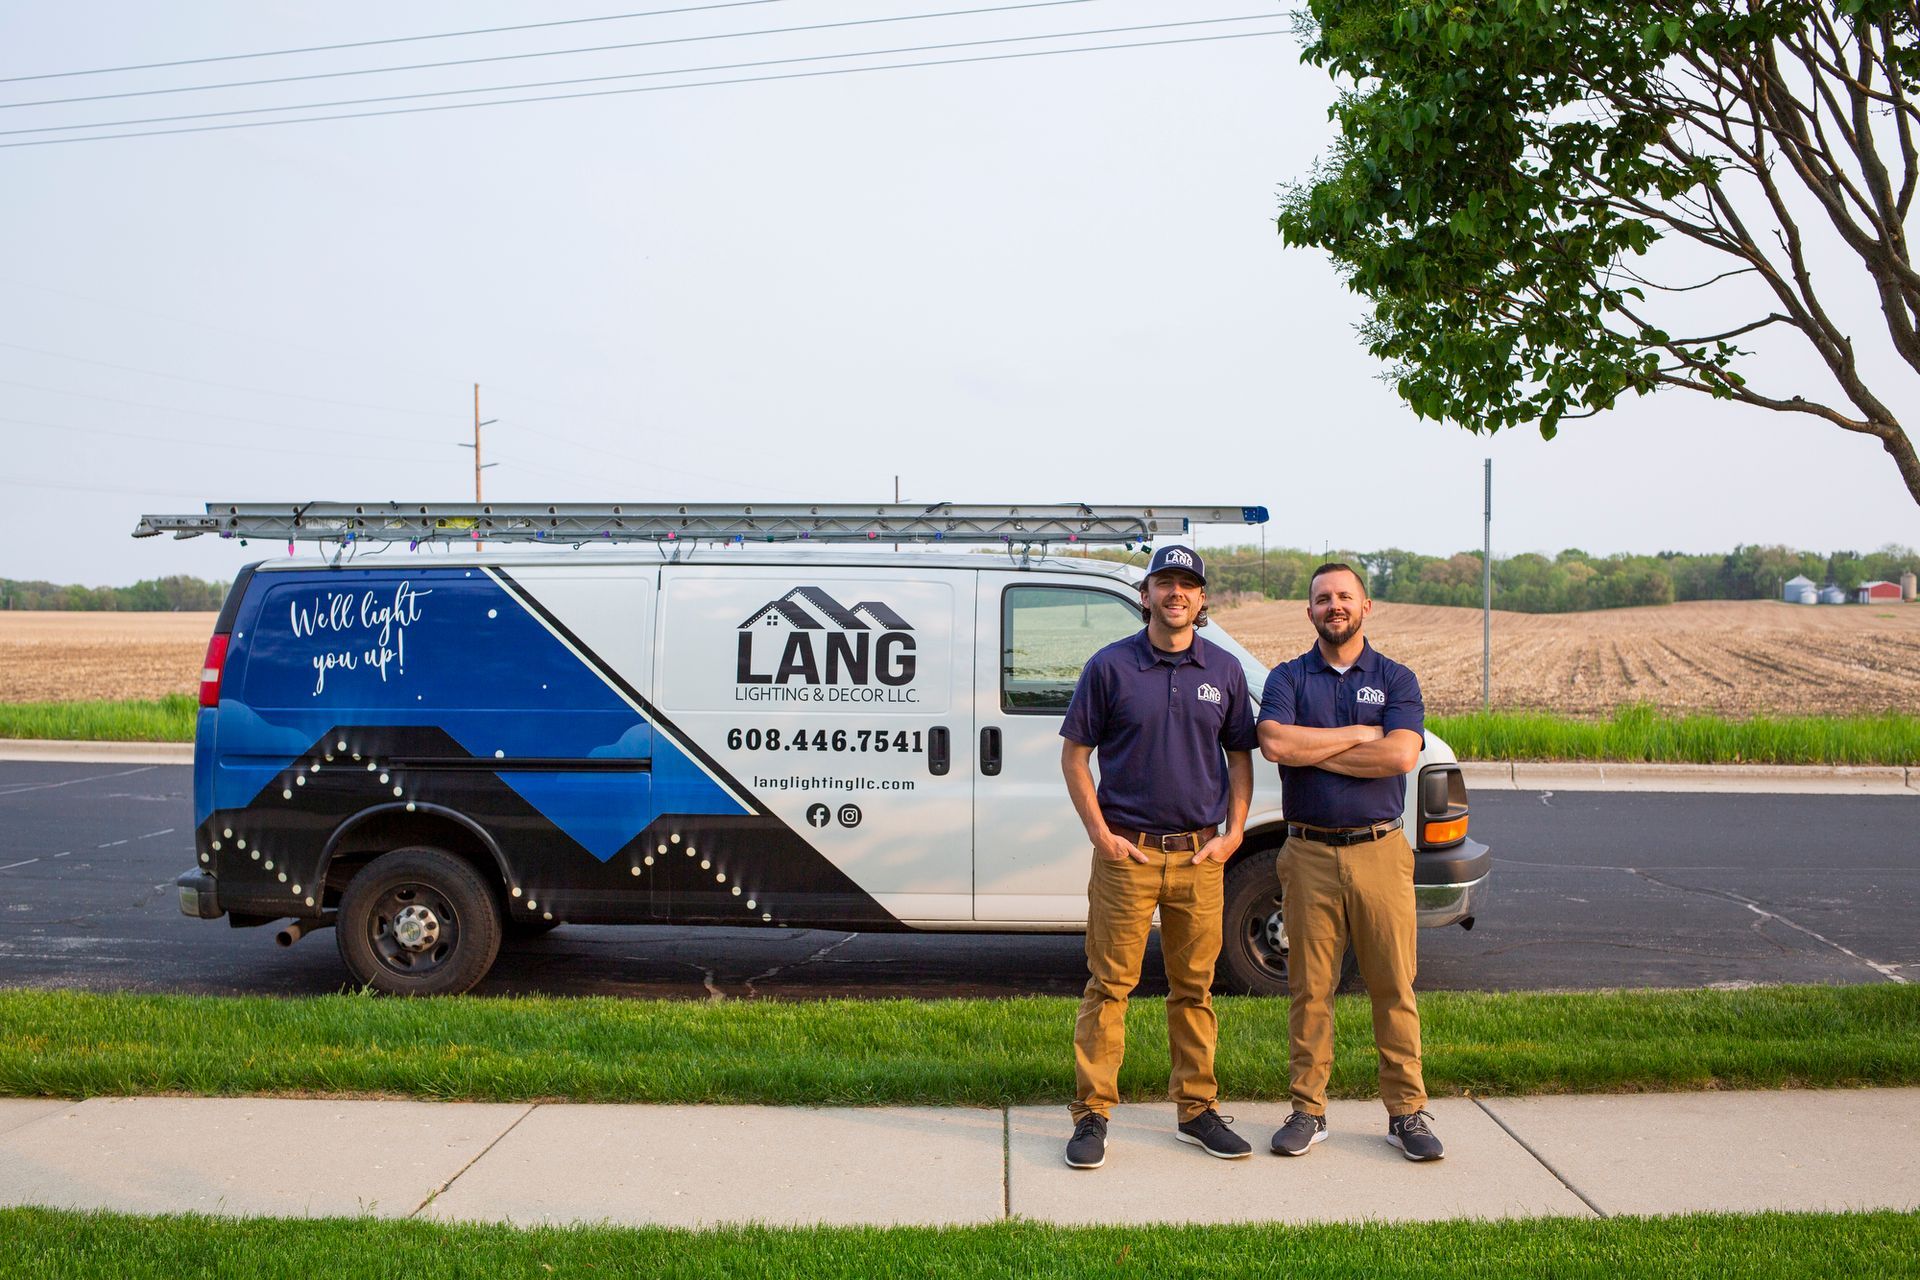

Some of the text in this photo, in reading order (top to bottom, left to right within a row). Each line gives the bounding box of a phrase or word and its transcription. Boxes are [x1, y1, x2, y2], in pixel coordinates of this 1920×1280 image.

[1165, 552, 1193, 567] LANG
[290, 580, 433, 647] We'll light
[312, 625, 404, 695] you up!
[736, 631, 917, 686] LANG
[735, 686, 920, 703] LIGHTING & DECOR LLC.
[1197, 687, 1221, 702] LANG
[1356, 690, 1385, 703] LANG
[727, 727, 923, 753] 608.446.7541
[753, 775, 915, 792] langlightingllc.com
